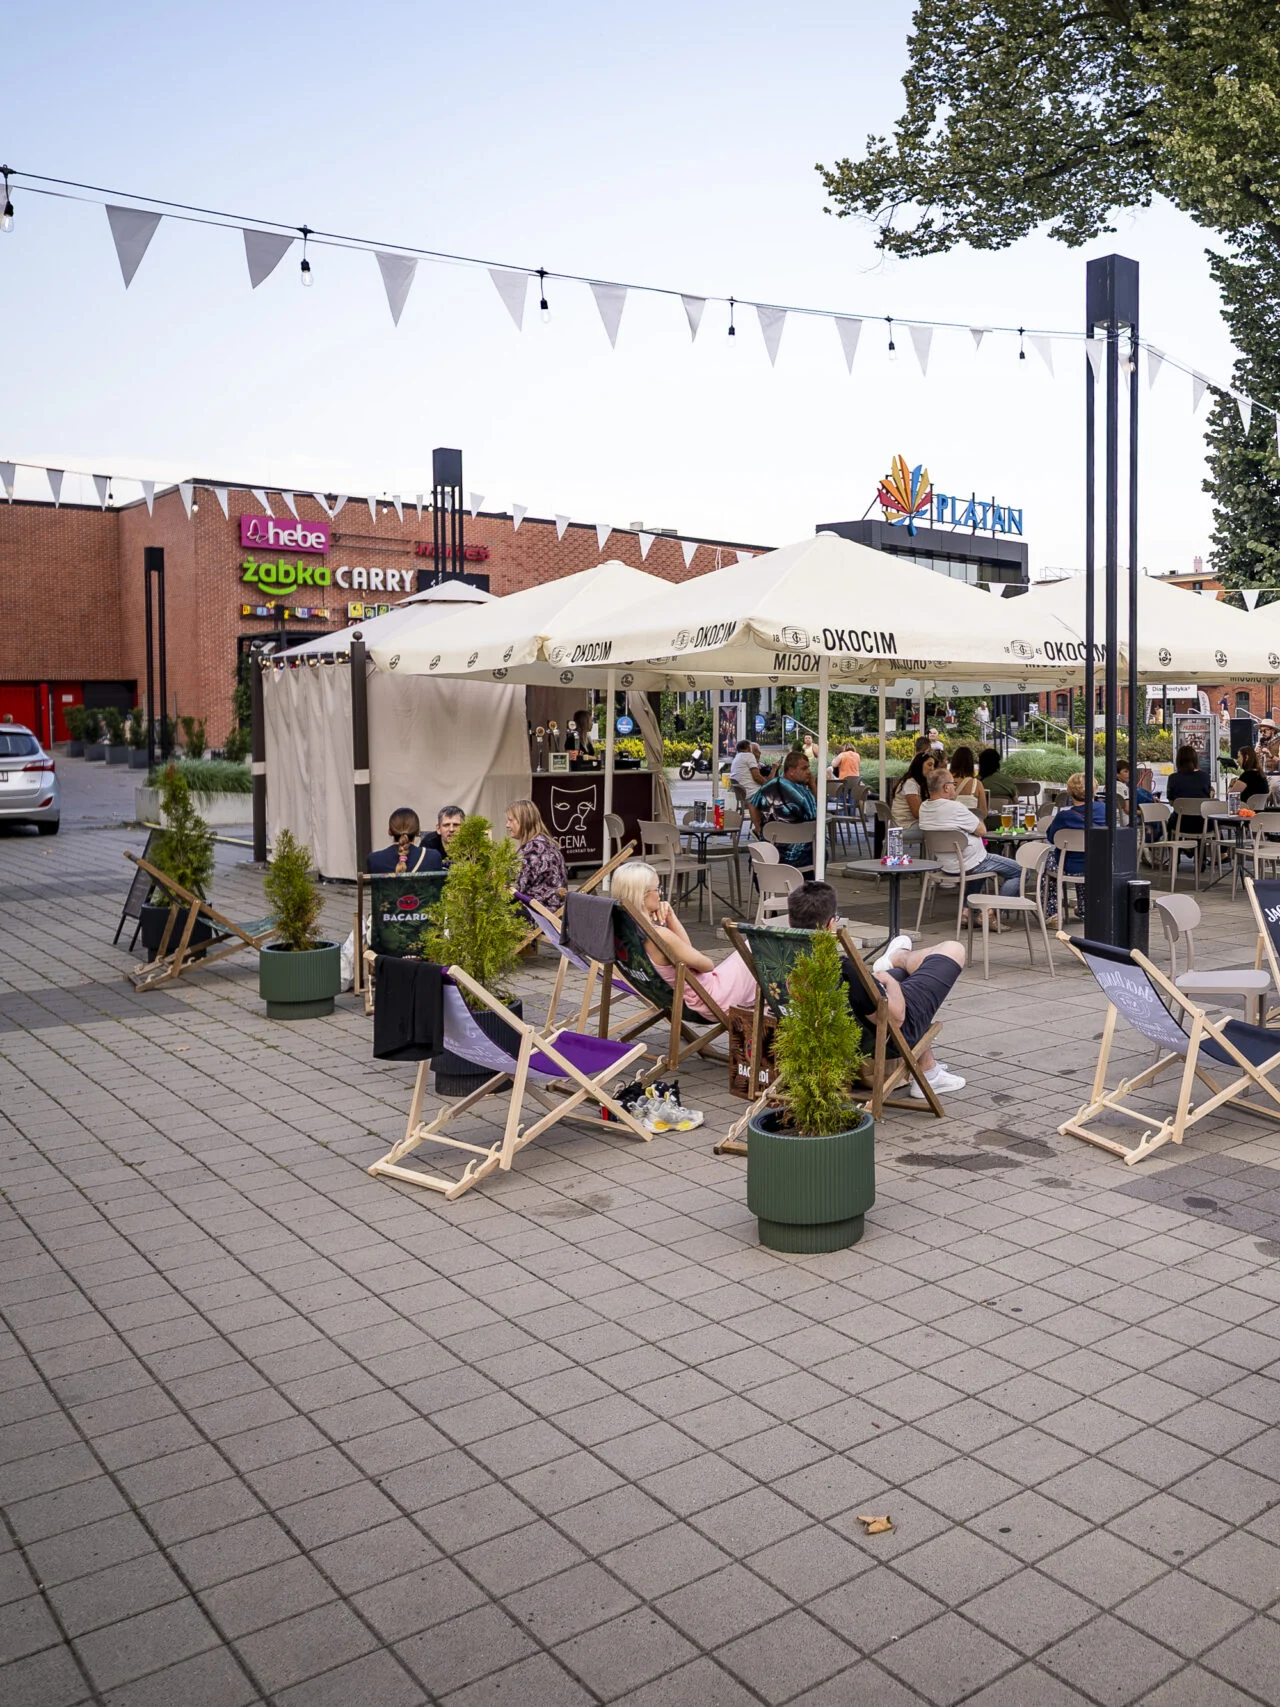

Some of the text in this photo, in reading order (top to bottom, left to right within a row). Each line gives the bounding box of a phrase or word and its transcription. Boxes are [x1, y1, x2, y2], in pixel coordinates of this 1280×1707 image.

[936, 493, 1023, 536] PLATAN
[268, 521, 326, 549] hebe
[242, 556, 331, 587] żabka
[335, 565, 415, 592] CARRY
[693, 621, 737, 648] OKOCIM
[812, 635, 821, 644] 45
[822, 628, 898, 655] OKOCIM
[570, 641, 612, 663] OKOCIM
[1043, 640, 1107, 663] OKOCM
[382, 913, 428, 922] BACARD
